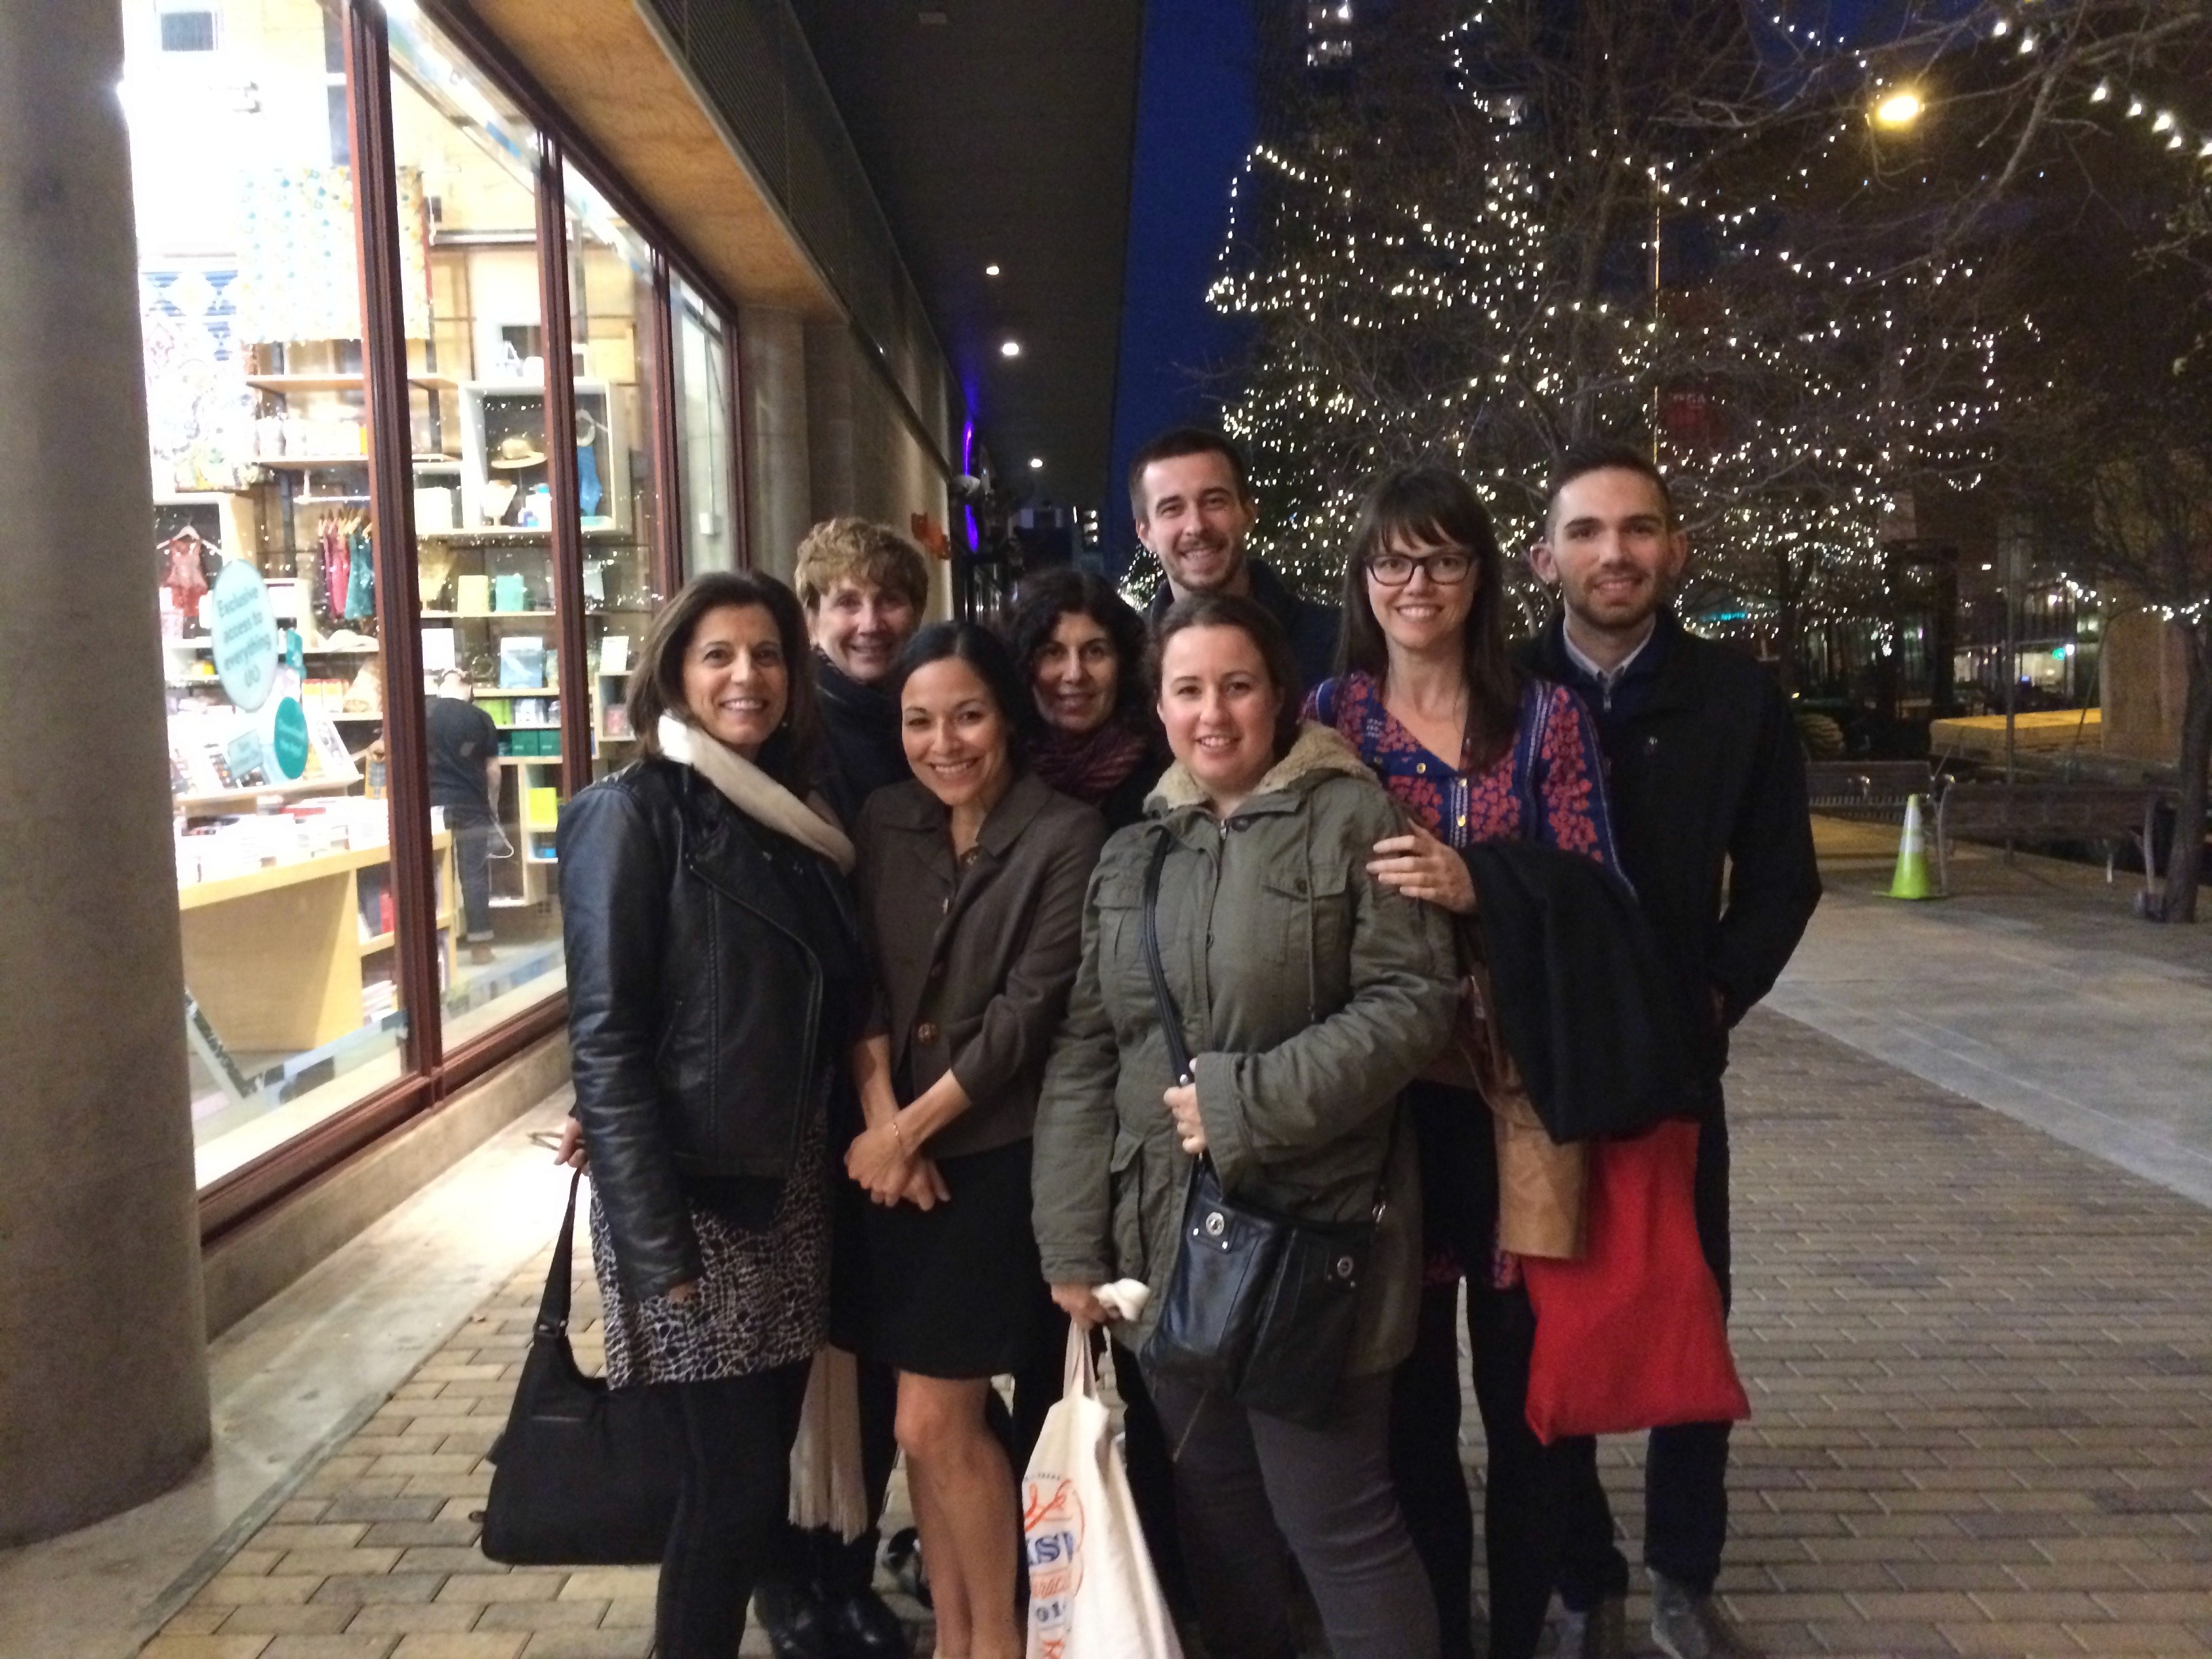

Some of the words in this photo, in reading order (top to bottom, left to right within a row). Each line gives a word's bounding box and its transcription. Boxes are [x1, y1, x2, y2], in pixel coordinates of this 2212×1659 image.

[218, 586, 258, 618] Exclusive
[224, 618, 253, 644] access
[252, 611, 264, 626] to
[224, 634, 271, 671] everything
